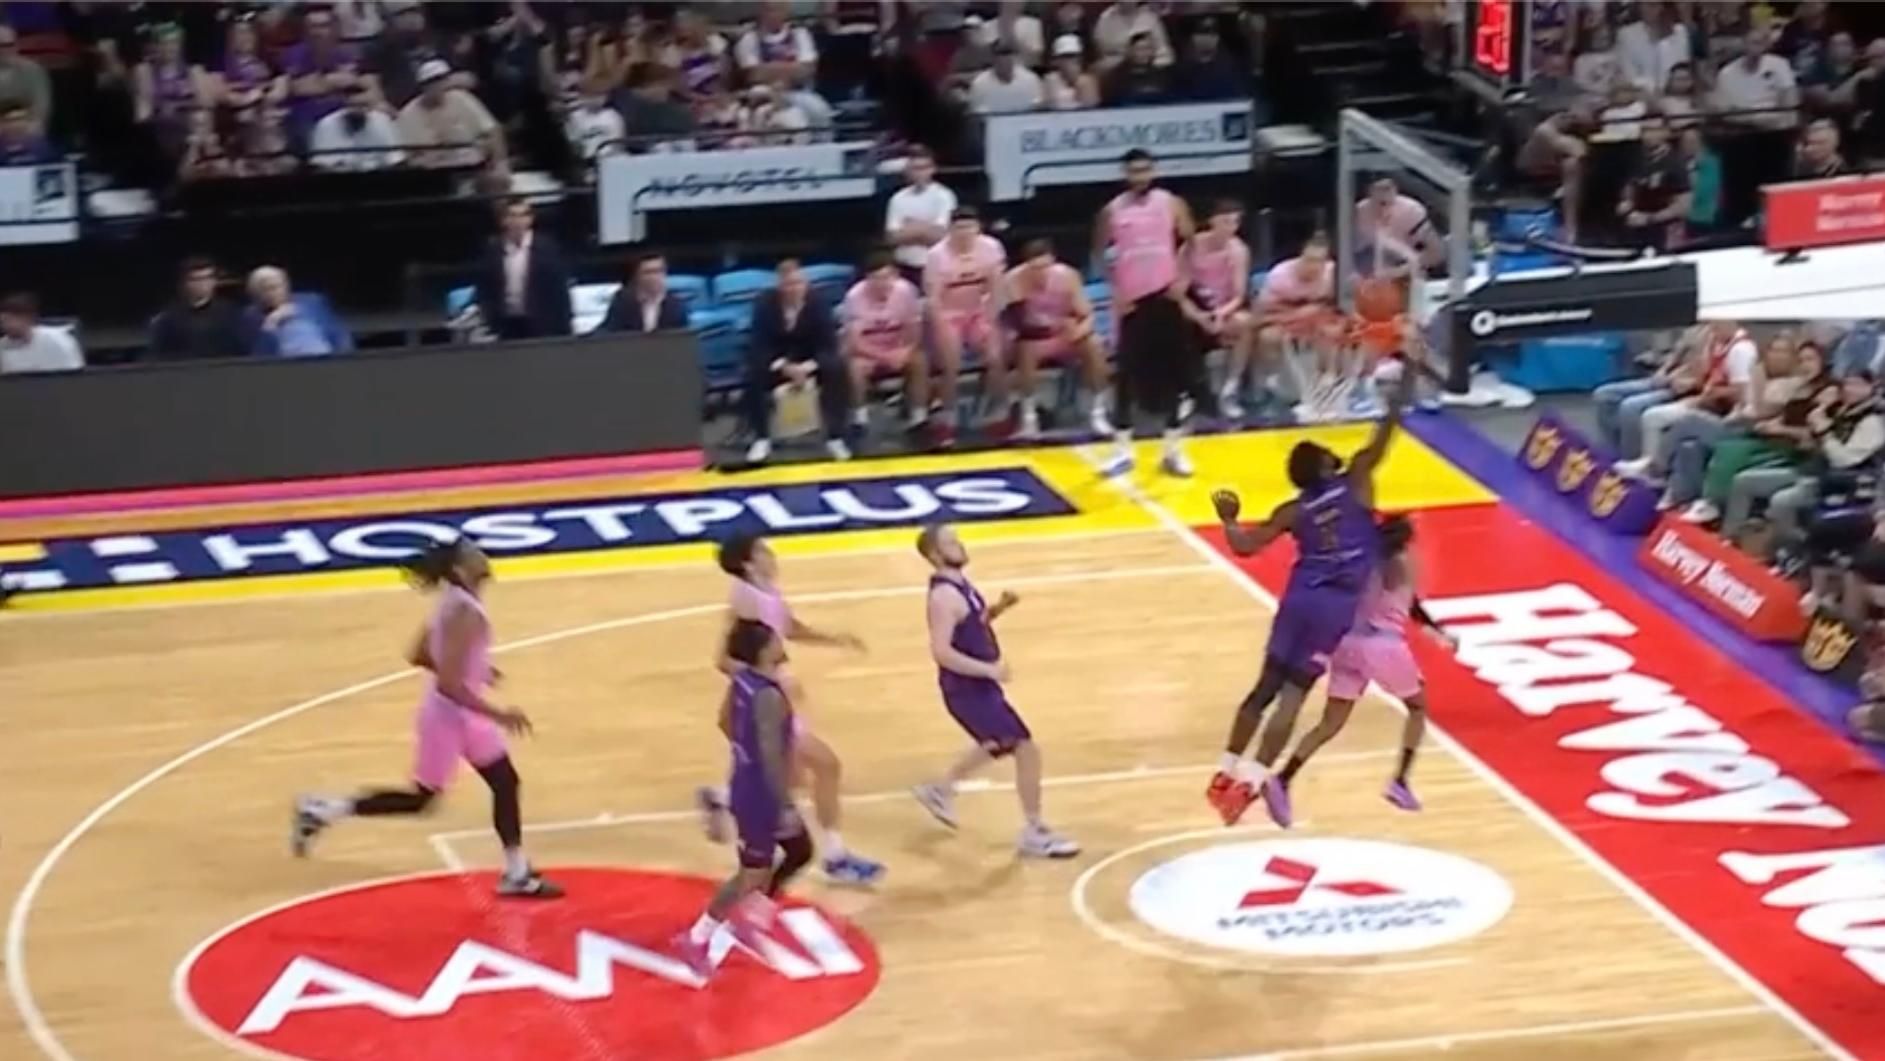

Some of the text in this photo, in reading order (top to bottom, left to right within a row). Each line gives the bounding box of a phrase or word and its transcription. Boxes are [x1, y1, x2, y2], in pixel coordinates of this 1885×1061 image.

[203, 477, 1033, 571] HOSTPLUS
[1650, 529, 1767, 619] Harvey Norman
[1420, 582, 1885, 986] Harvey No
[235, 908, 866, 1036] AAMI
